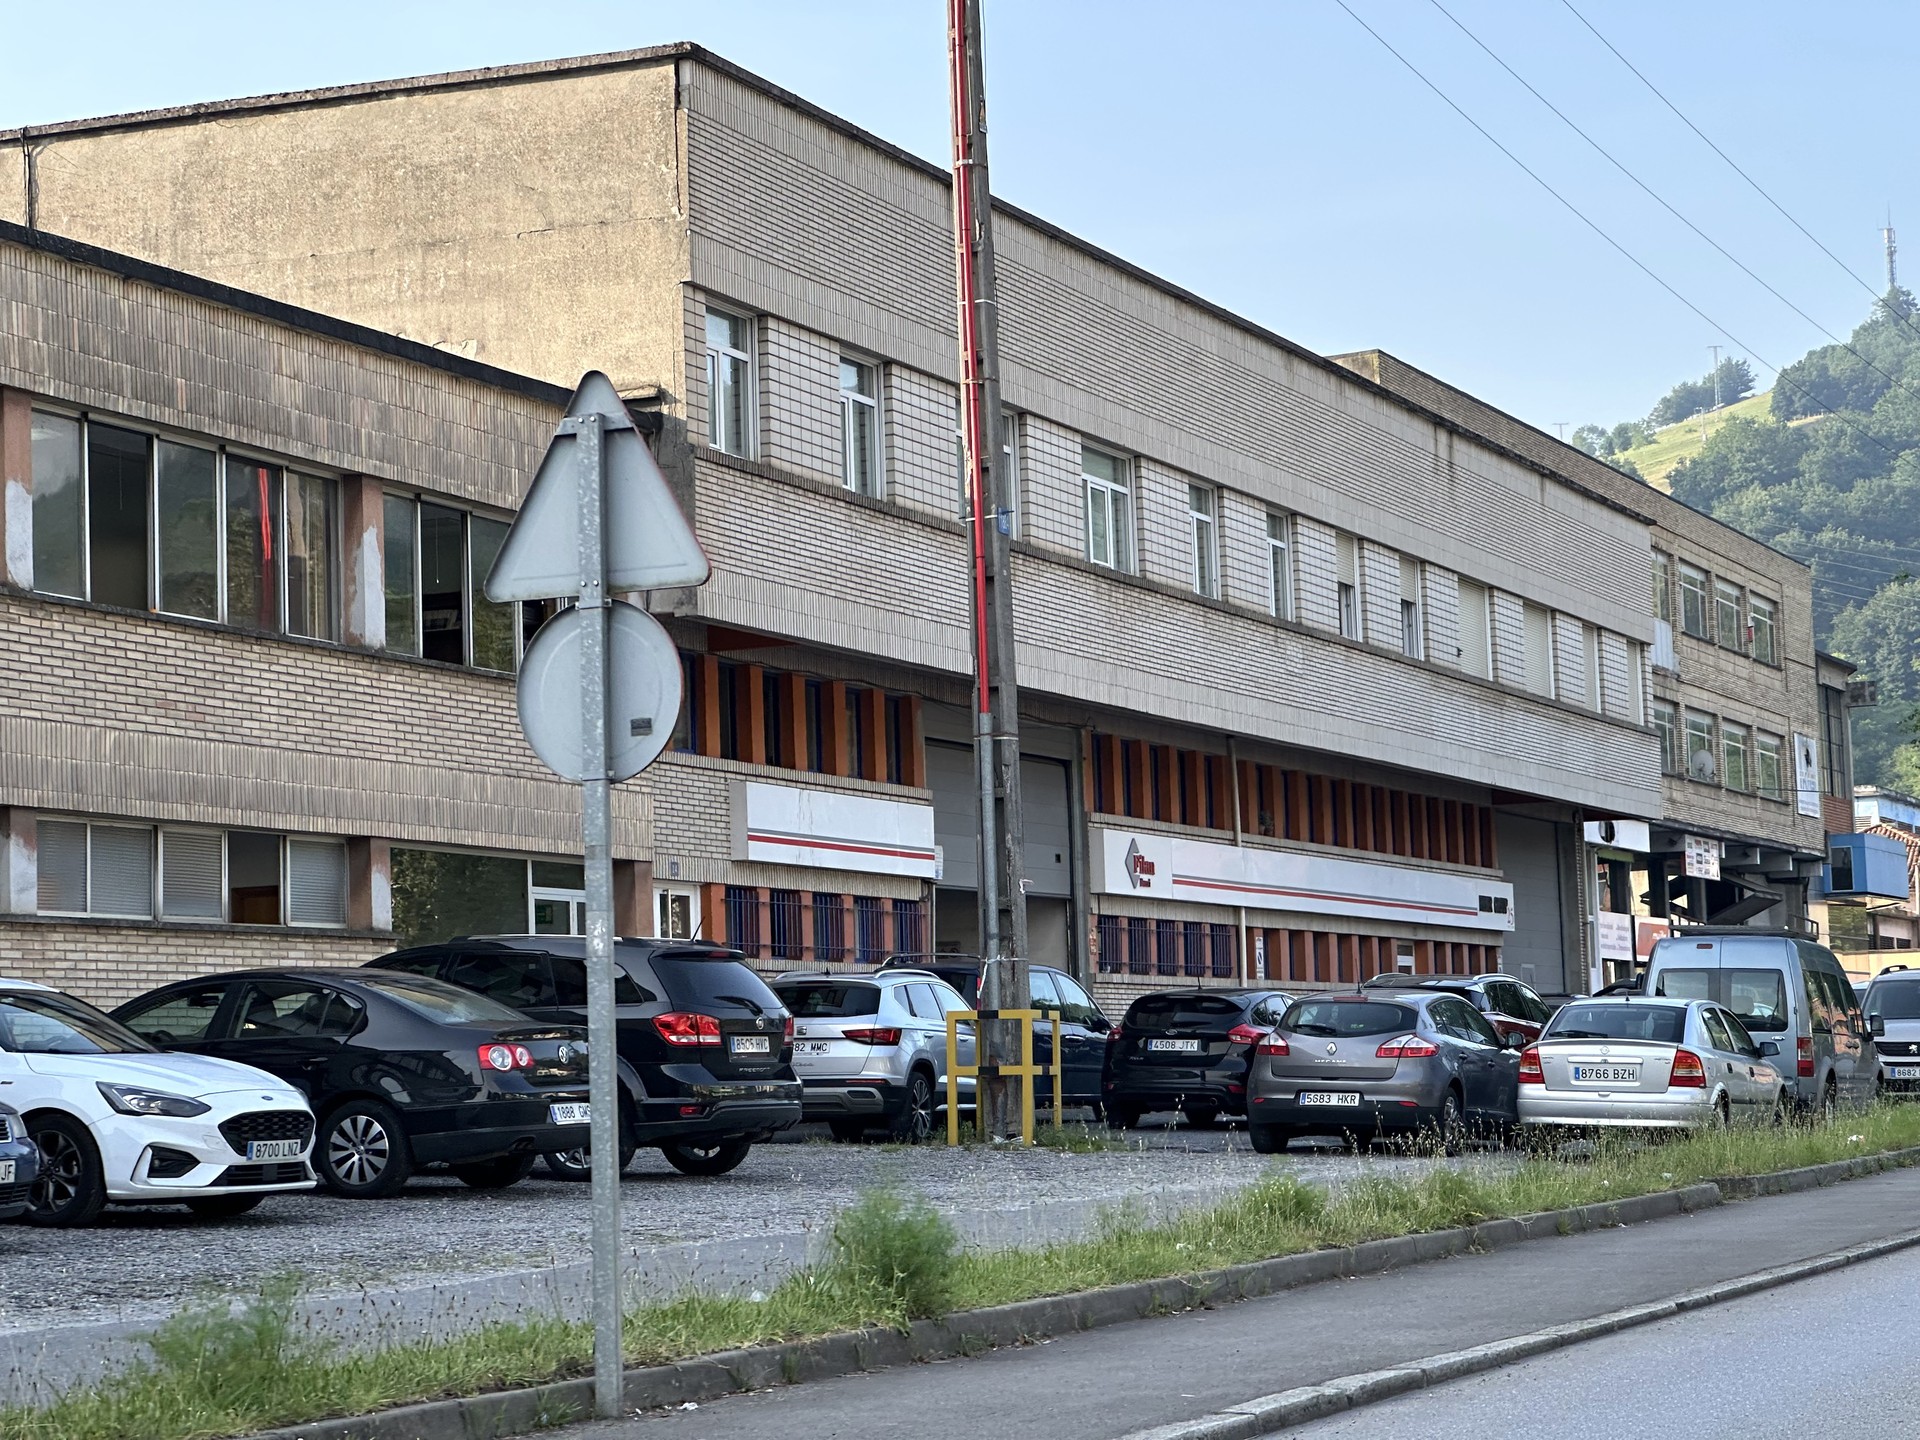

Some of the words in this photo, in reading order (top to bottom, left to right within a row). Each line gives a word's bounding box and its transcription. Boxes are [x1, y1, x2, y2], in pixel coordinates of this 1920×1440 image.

[792, 1042, 806, 1052] 82
[810, 1042, 828, 1052] MMC
[1154, 1041, 1176, 1049] 4508
[1179, 1041, 1196, 1050] JTK
[1580, 1068, 1609, 1079] 8766
[1613, 1068, 1635, 1080] BZH
[1306, 1093, 1332, 1104] 5683
[1337, 1094, 1357, 1105] HKR
[557, 1106, 575, 1119] 1888
[255, 1143, 280, 1158] 8700
[282, 1141, 299, 1157] LNZ
